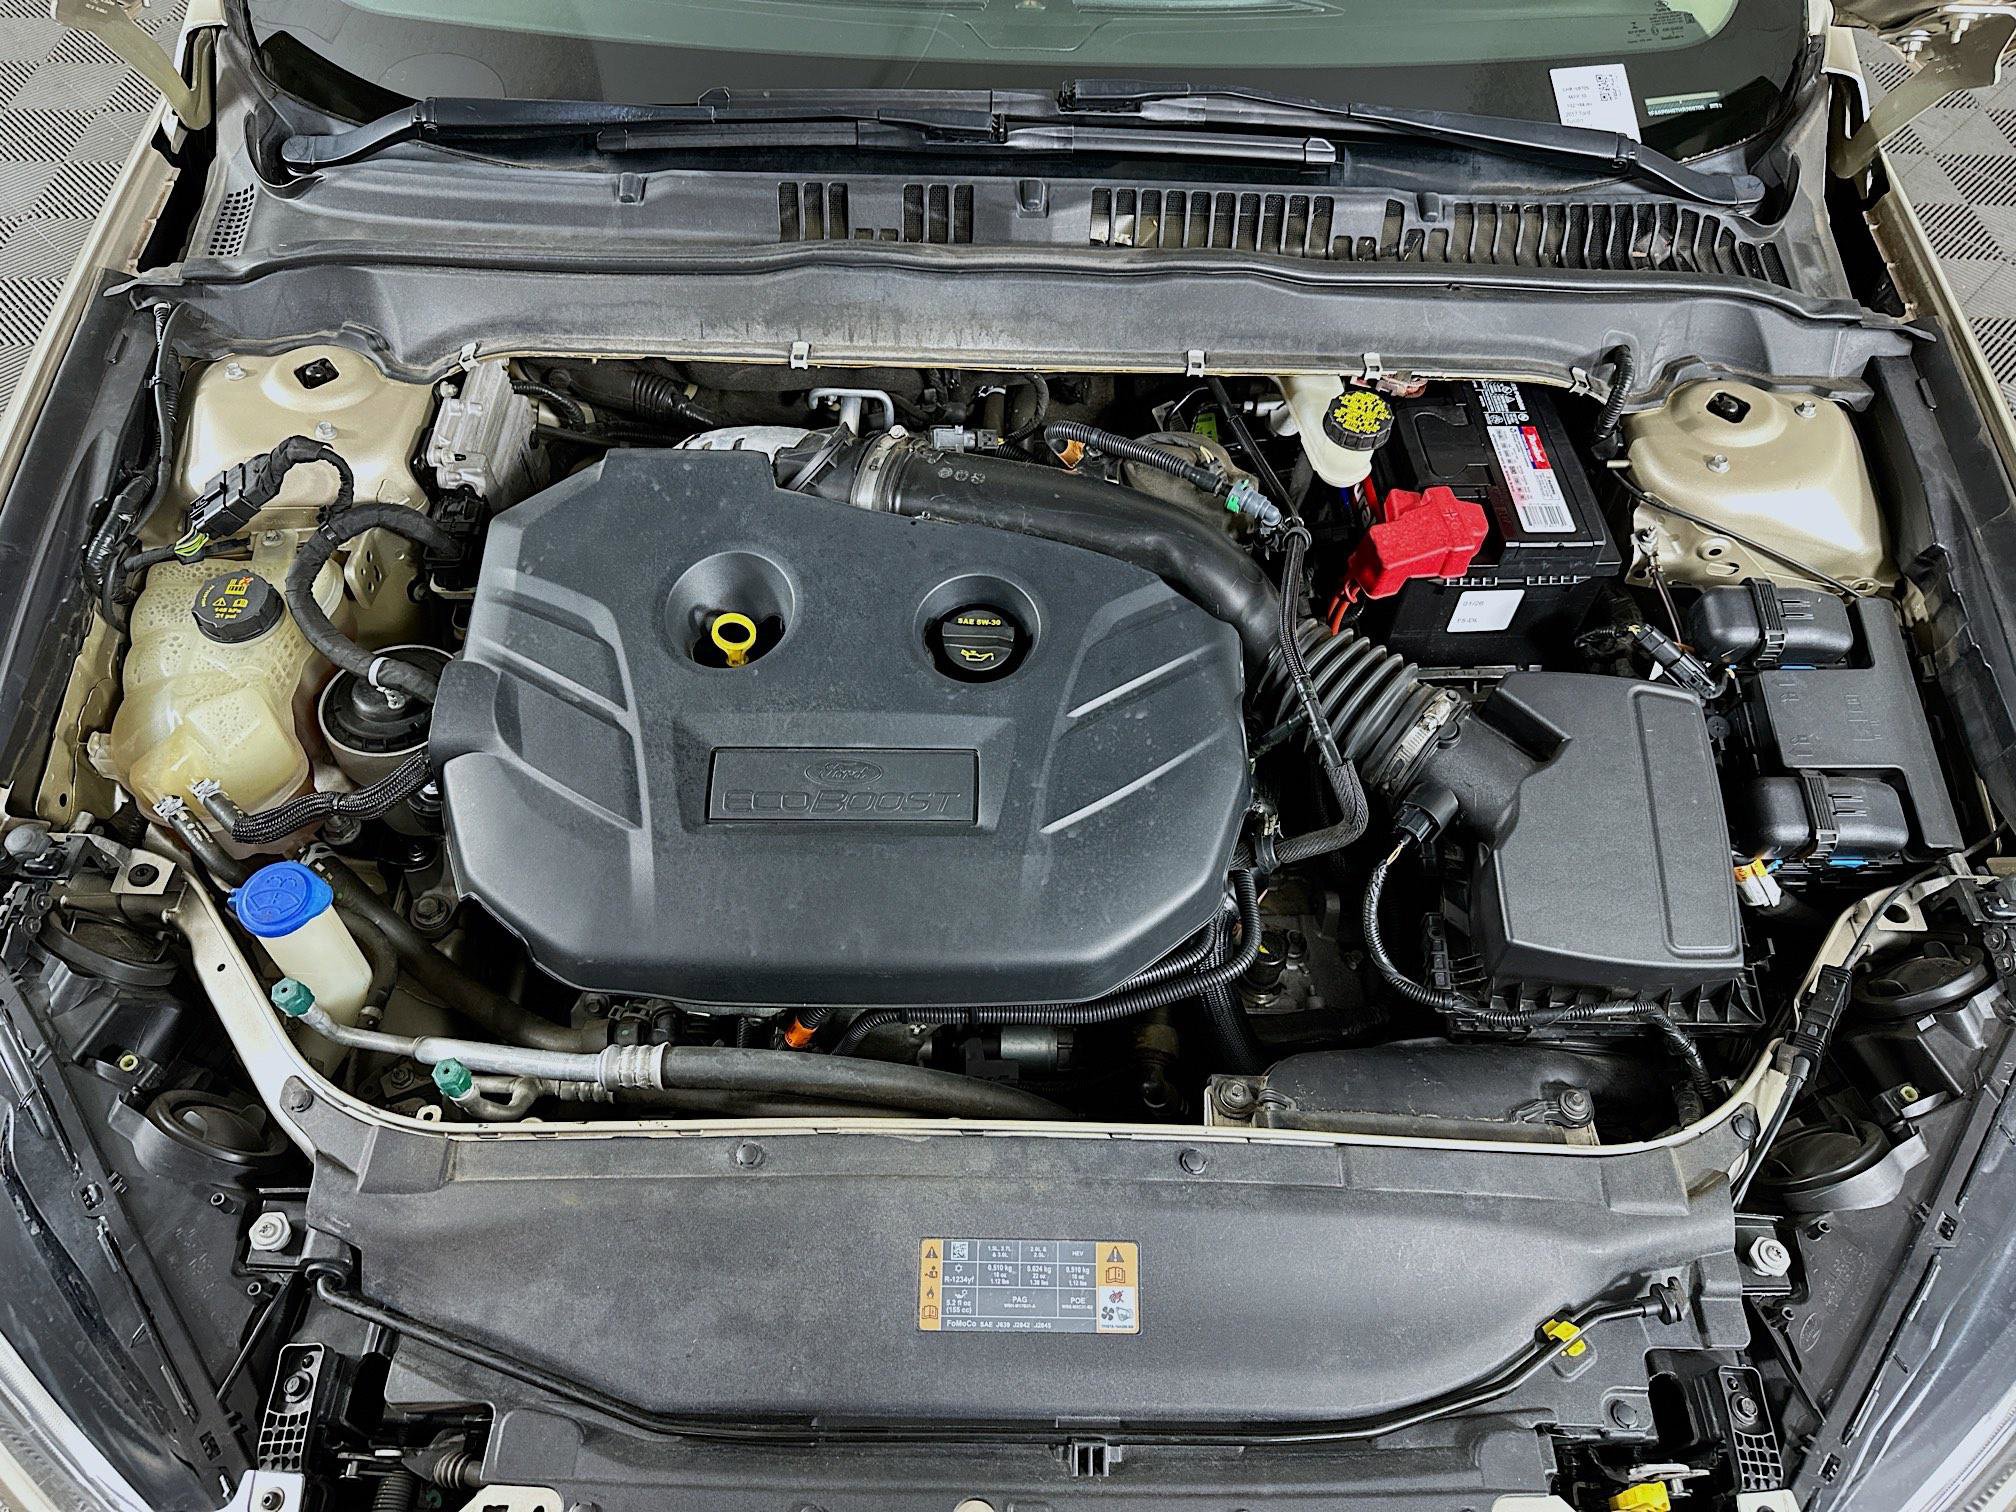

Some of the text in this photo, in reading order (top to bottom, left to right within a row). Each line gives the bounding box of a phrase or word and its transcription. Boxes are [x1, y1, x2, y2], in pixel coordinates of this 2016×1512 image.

[957, 617, 1002, 626] SAE 5W-30
[819, 759, 870, 780] Ford
[944, 1275, 975, 1284] R-1234yf
[1070, 1296, 1086, 1304] POE
[946, 1306, 960, 1314] (155
[946, 1319, 976, 1327] FoMoCo
